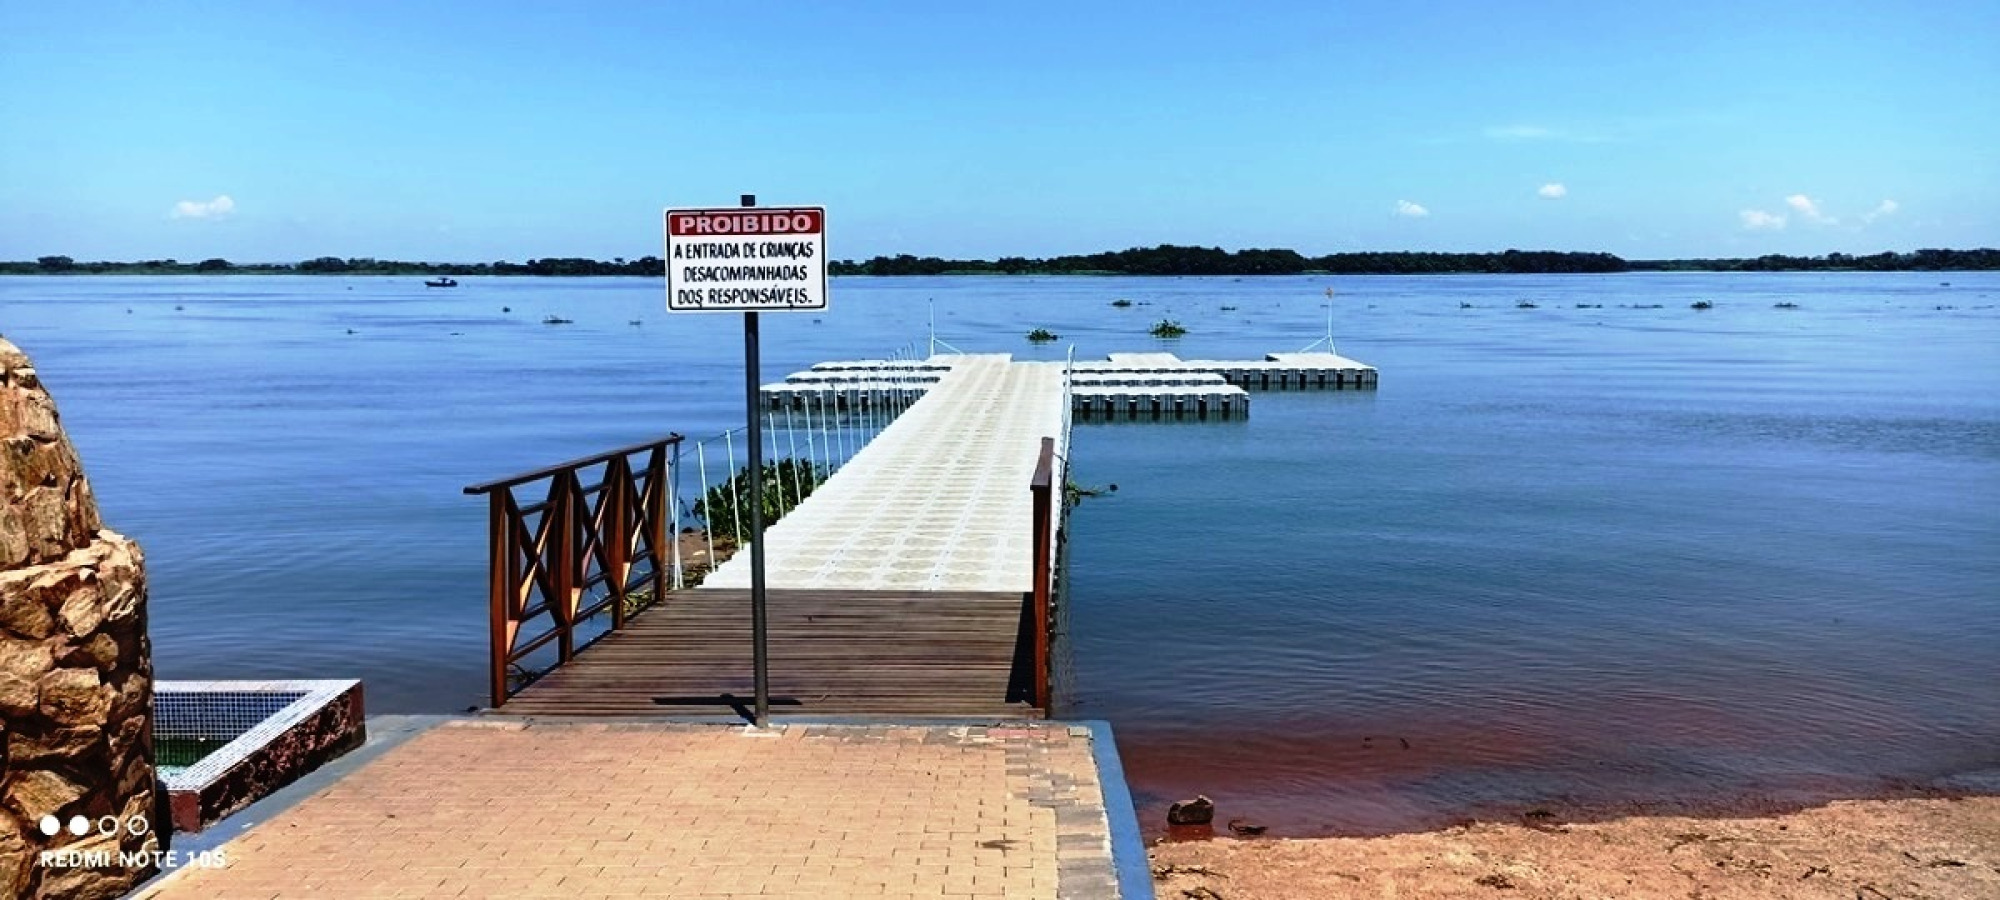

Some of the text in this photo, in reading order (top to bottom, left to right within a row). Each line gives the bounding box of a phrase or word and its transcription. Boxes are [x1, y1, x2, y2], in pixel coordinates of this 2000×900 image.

[679, 214, 812, 234] PROIBIDO
[674, 241, 814, 260] A ENTRADA DE CRIANÇAS
[684, 265, 807, 282] DESACOMPANHADAS
[678, 283, 812, 305] DOS RESPONSÁVEIS.
